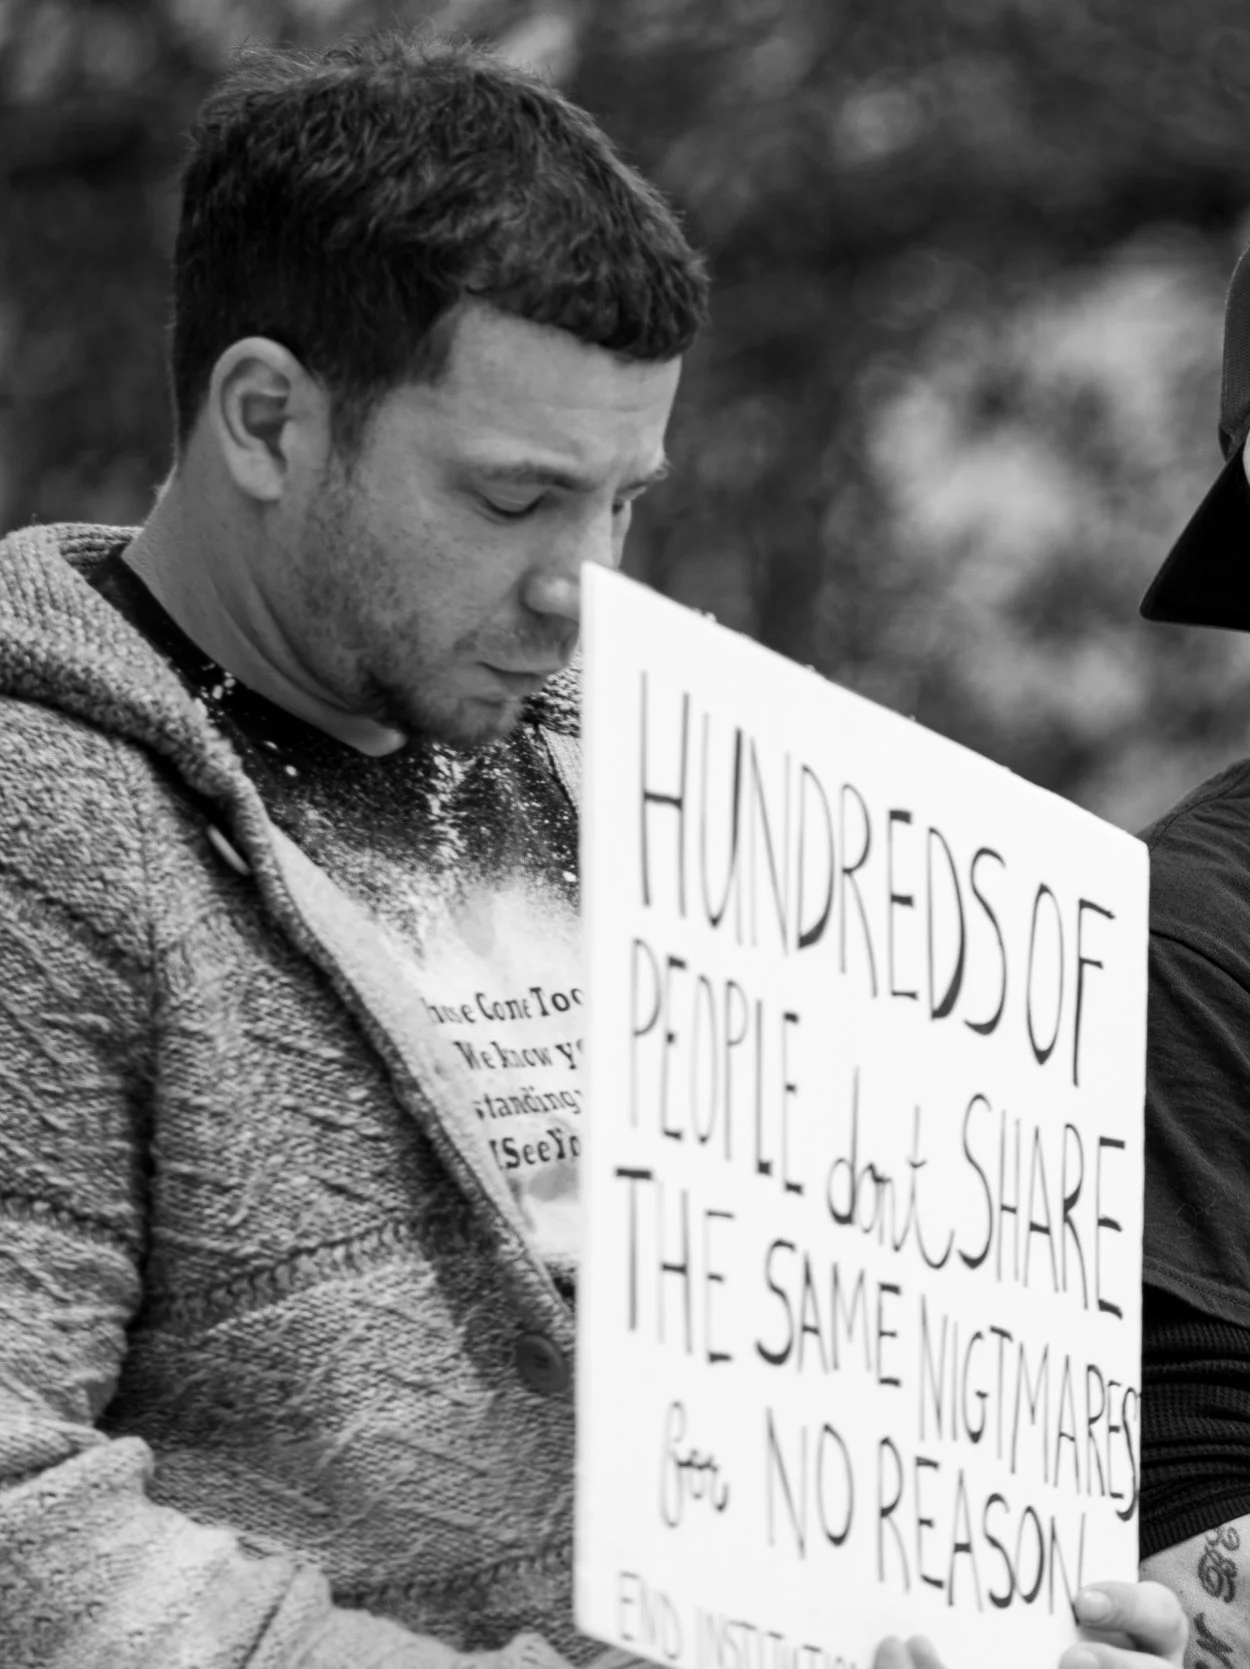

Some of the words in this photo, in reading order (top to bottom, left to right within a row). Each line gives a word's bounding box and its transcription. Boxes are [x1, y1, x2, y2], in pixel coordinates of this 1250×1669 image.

[637, 669, 1007, 1036] HUNDREDS
[1026, 882, 1117, 1088] OF
[630, 936, 803, 1196] PEOPLE
[957, 1093, 1126, 1320] SHARE
[613, 1166, 736, 1364] THE
[756, 1238, 902, 1387] SAME
[915, 1292, 1142, 1523] NIGTMARES
[764, 1405, 857, 1560] NO
[875, 1435, 1088, 1627] REASON
[618, 1568, 683, 1661] END
